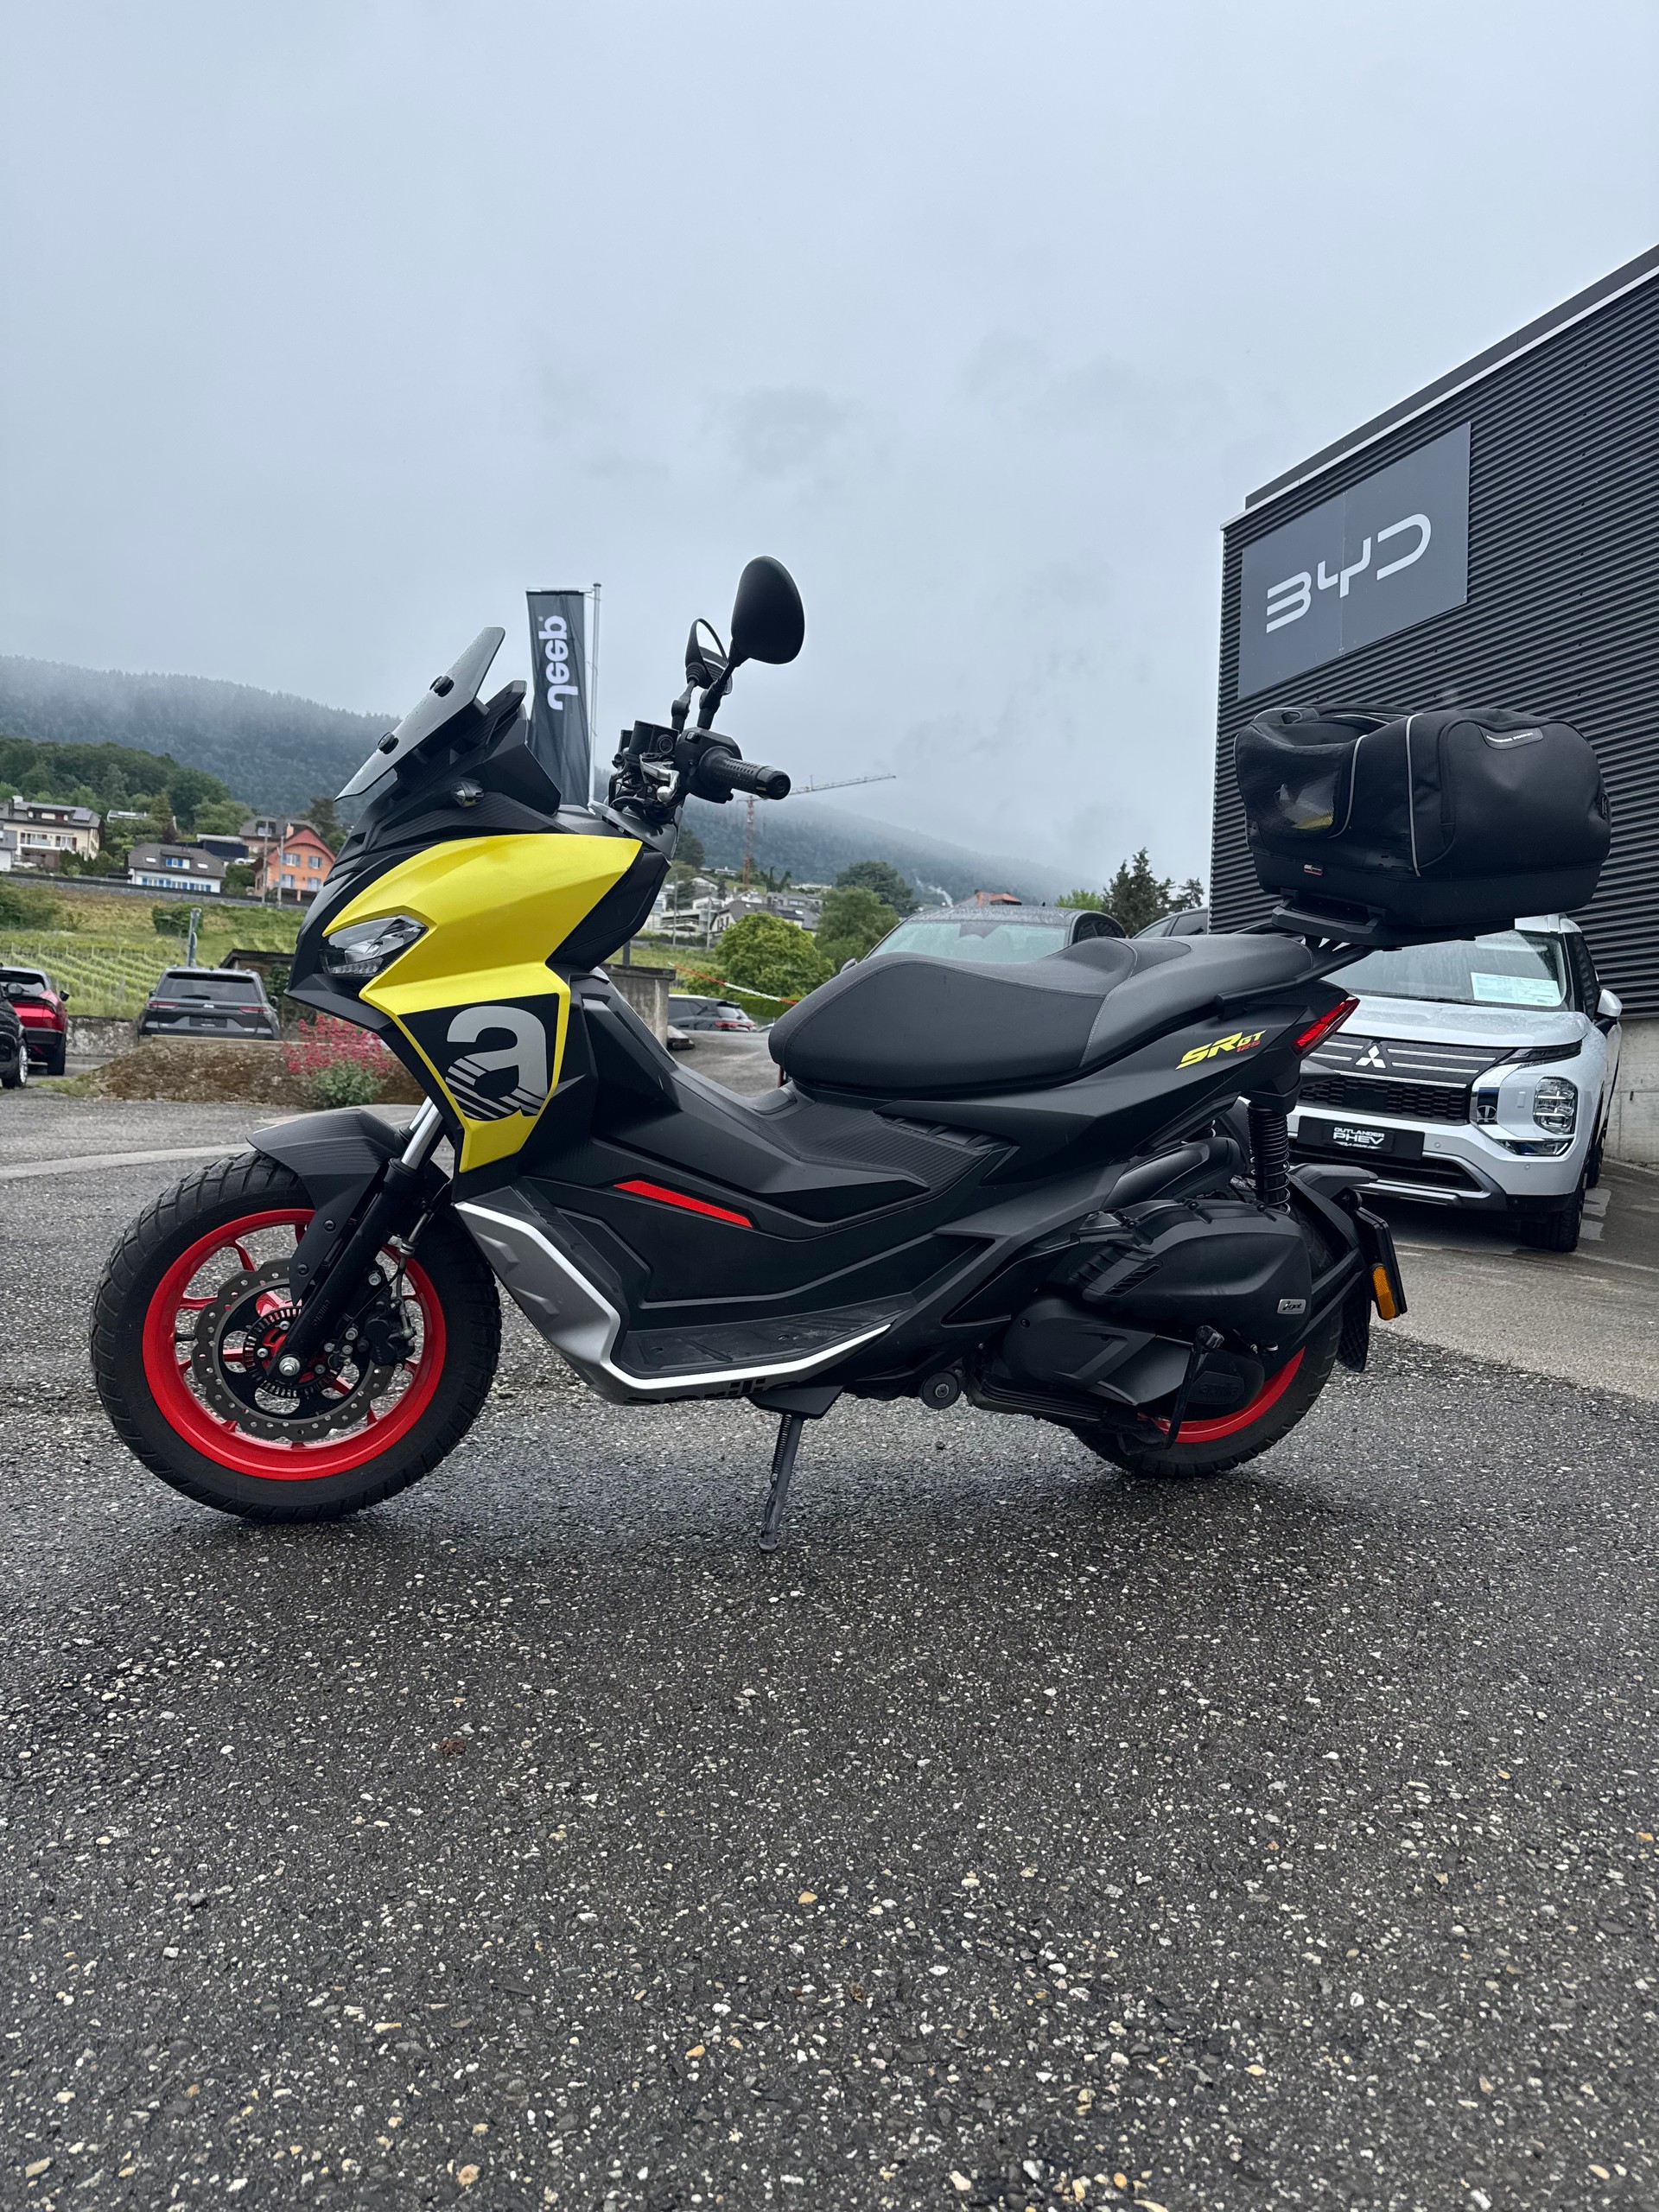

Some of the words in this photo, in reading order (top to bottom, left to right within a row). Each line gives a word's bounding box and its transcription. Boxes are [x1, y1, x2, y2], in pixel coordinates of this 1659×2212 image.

[1266, 513, 1432, 634] BYD
[1332, 1132, 1384, 1145] PHEV
[1333, 1127, 1385, 1138] OUTLANDER
